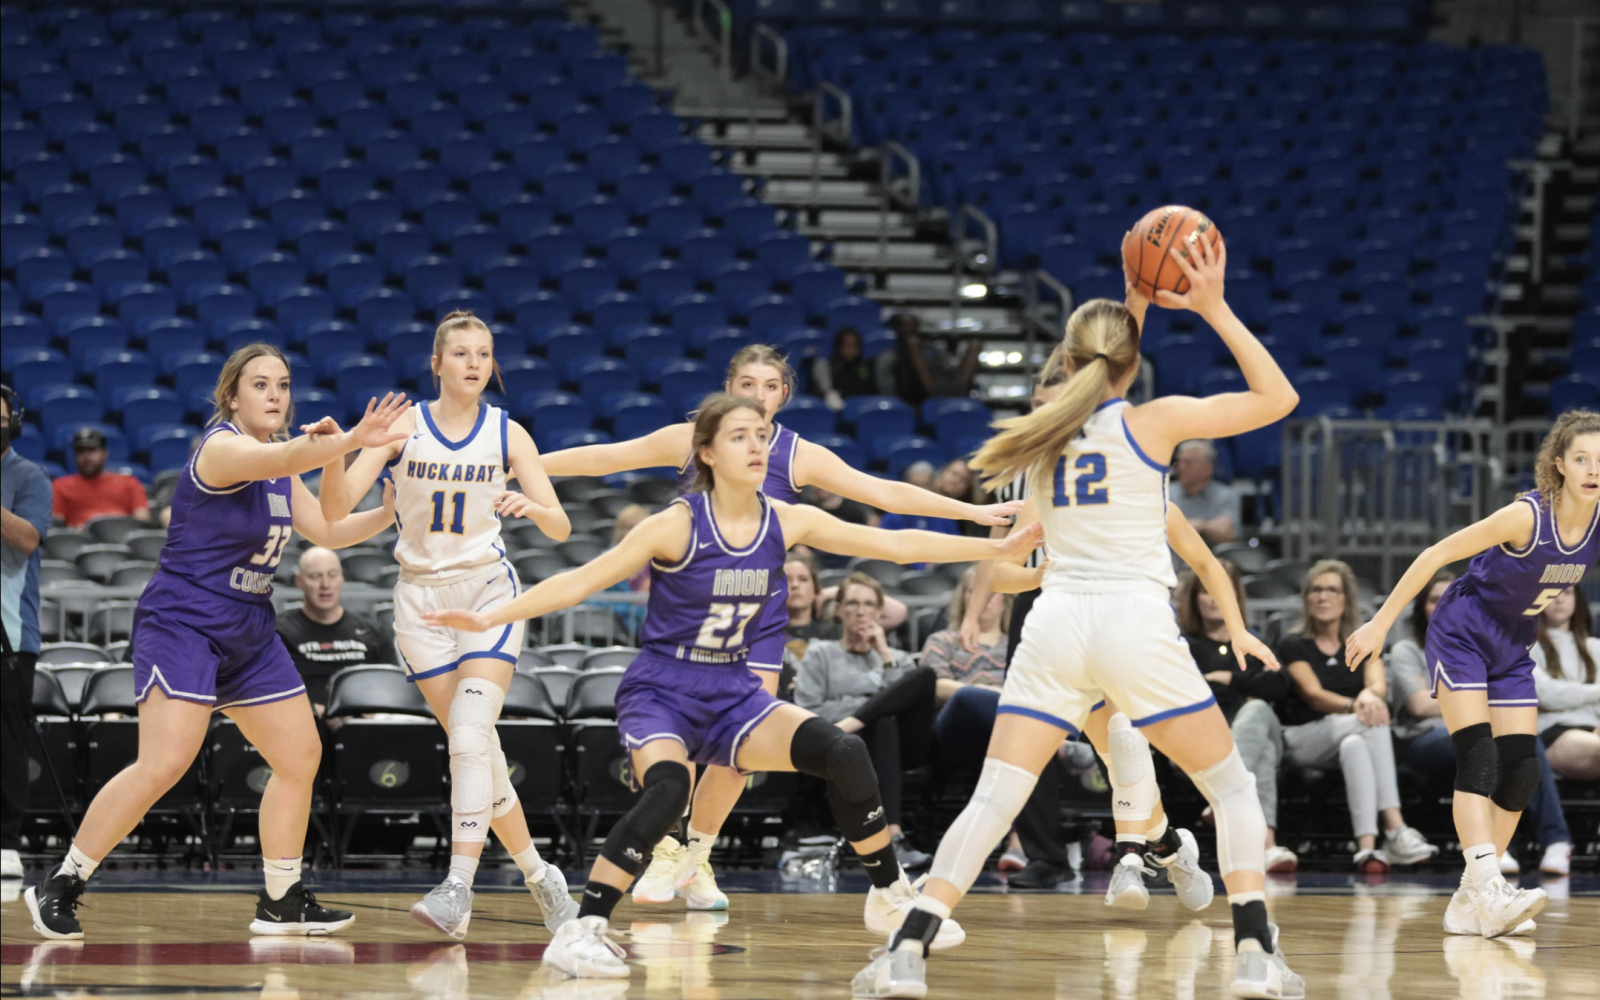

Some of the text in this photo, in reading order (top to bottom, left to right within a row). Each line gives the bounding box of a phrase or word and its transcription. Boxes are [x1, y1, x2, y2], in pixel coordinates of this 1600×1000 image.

[406, 459, 497, 483] HUCKABAY
[1051, 451, 1111, 508] 12
[428, 489, 468, 537] 11
[249, 525, 292, 568] 33
[712, 568, 769, 596] IRION
[1538, 563, 1587, 584] IRION
[1521, 588, 1563, 616] 5
[381, 761, 397, 788] 6
